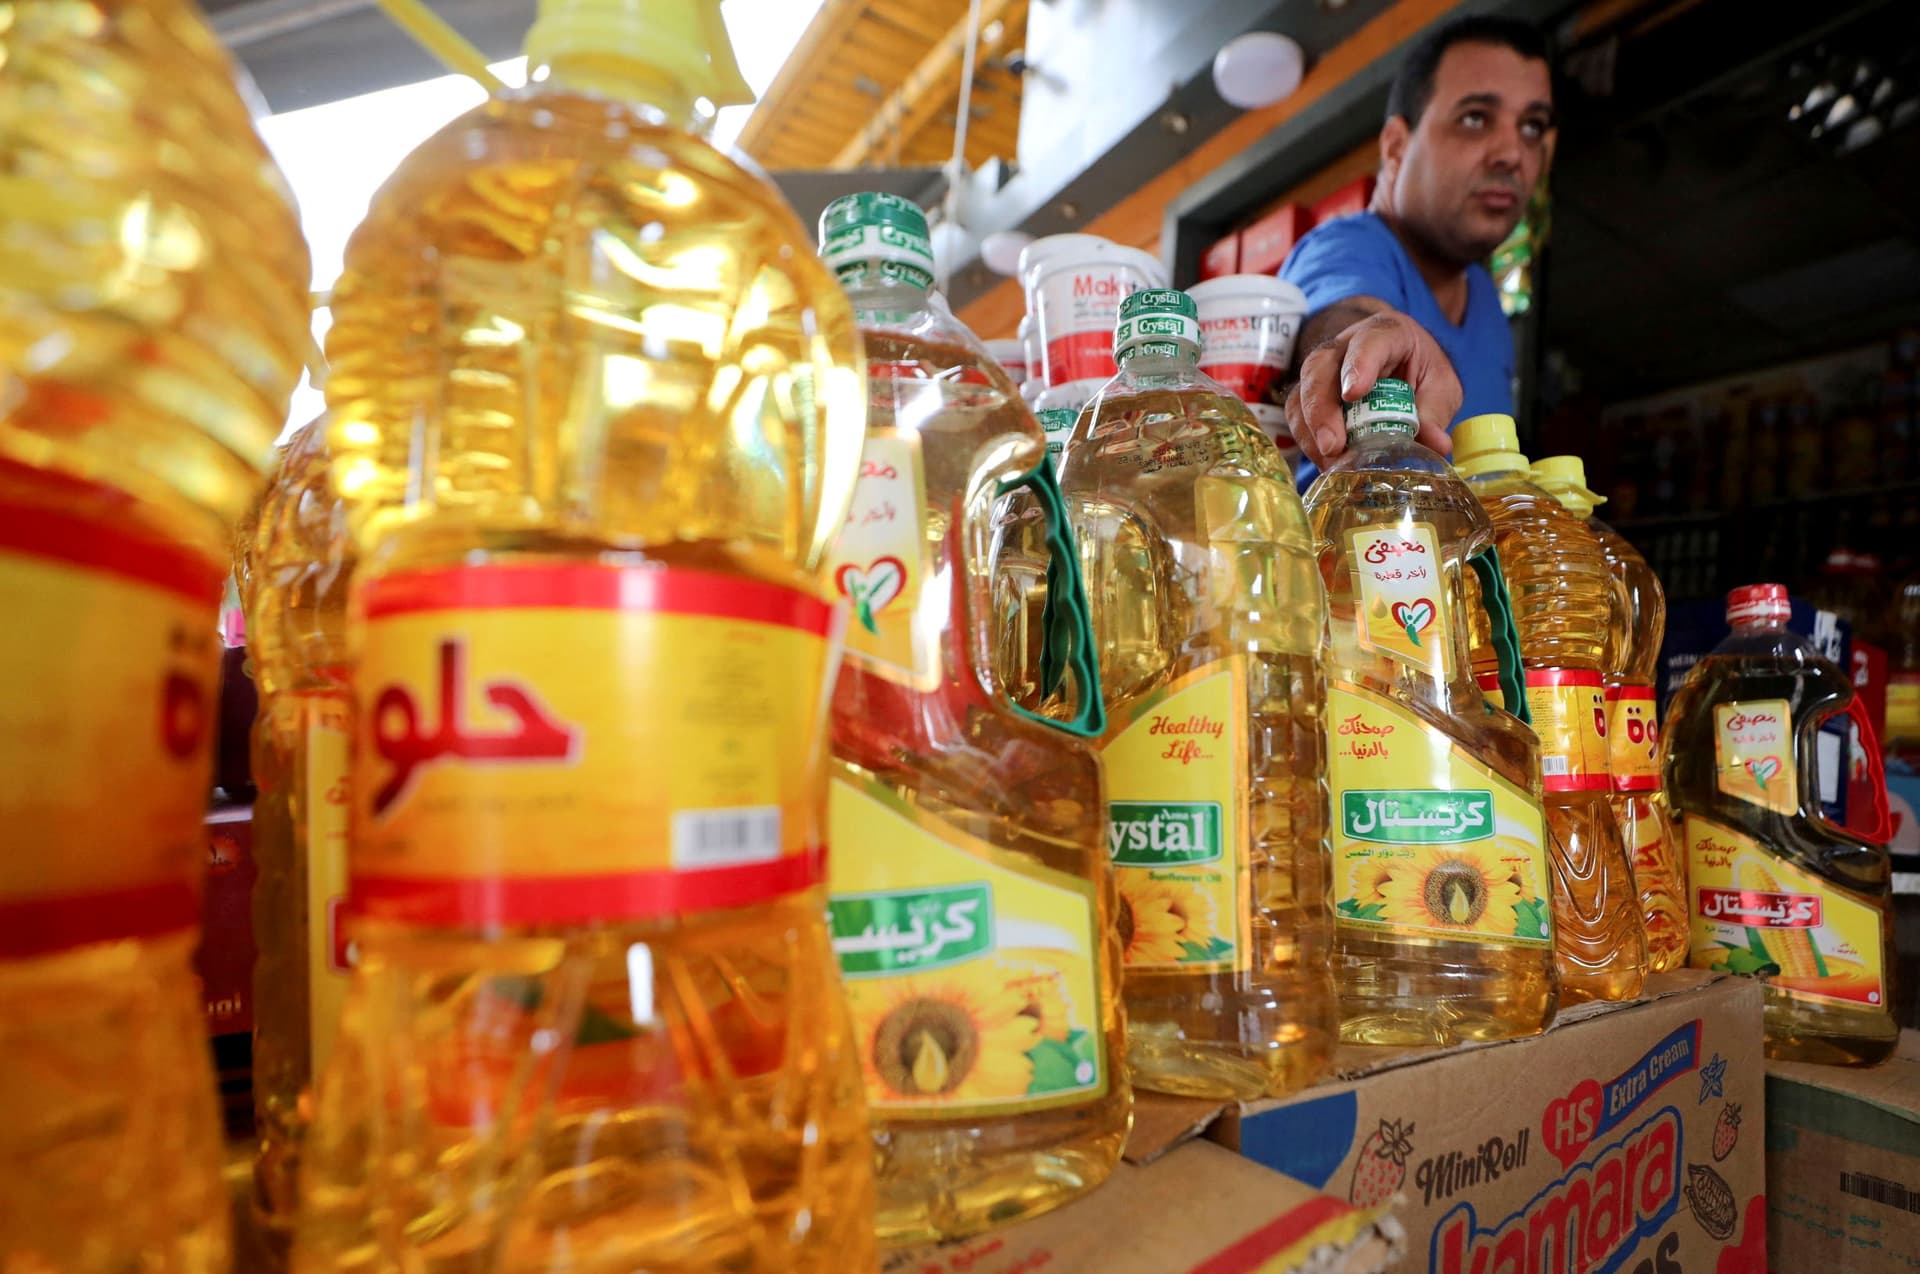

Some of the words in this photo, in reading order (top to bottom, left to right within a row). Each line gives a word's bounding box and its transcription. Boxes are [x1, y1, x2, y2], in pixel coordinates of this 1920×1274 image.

[1142, 292, 1181, 306] Crystal
[1139, 320, 1182, 333] Crystal
[1150, 715, 1224, 740] Healthy
[1351, 798, 1487, 836] كريستال
[1109, 811, 1208, 859] ystal
[1704, 894, 1815, 925] كريستال
[1610, 1069, 1648, 1117] Extra
[1649, 1037, 1691, 1081] Cream
[1554, 1096, 1595, 1150] HS
